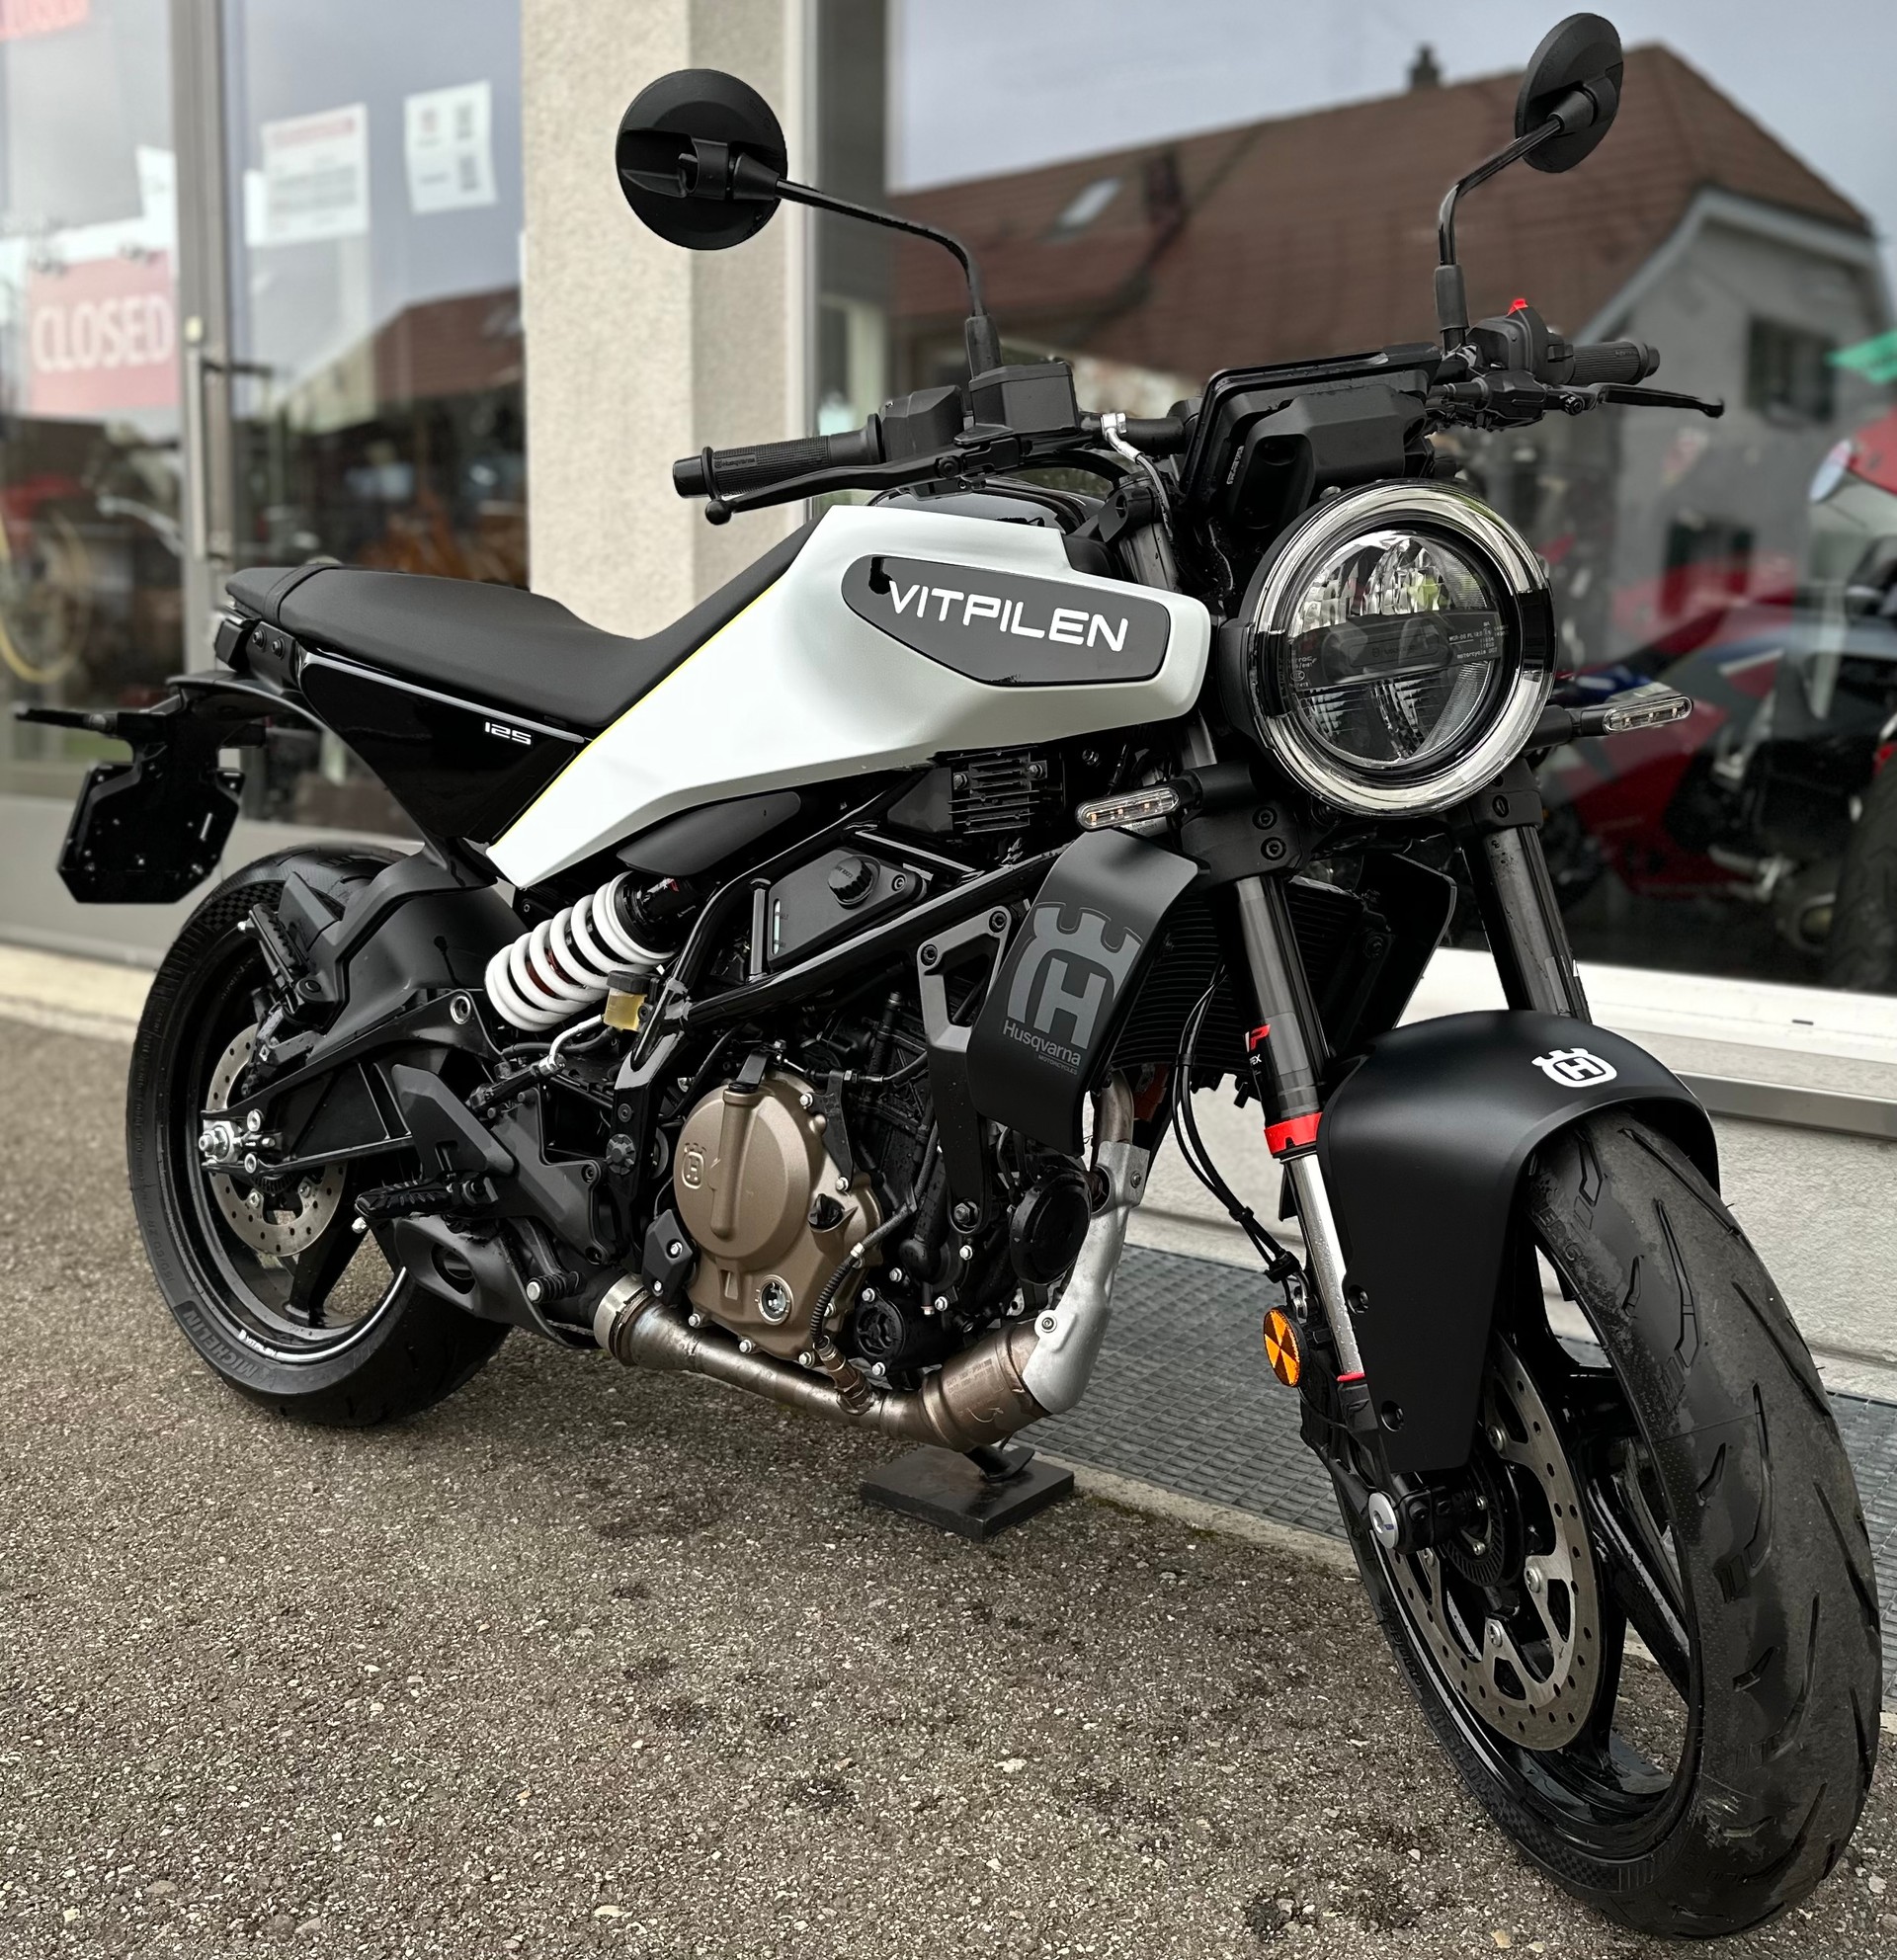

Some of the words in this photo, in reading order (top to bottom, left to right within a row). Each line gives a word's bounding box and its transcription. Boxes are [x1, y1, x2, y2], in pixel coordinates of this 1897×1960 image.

[35, 295, 171, 371] CLOSED
[889, 580, 1128, 652] VITPILEN
[485, 722, 532, 745] 125
[1003, 1020, 1081, 1066] Husqvarna
[1037, 1054, 1078, 1075] MOTORCYCLES
[182, 1310, 259, 1379] MICHELIN
